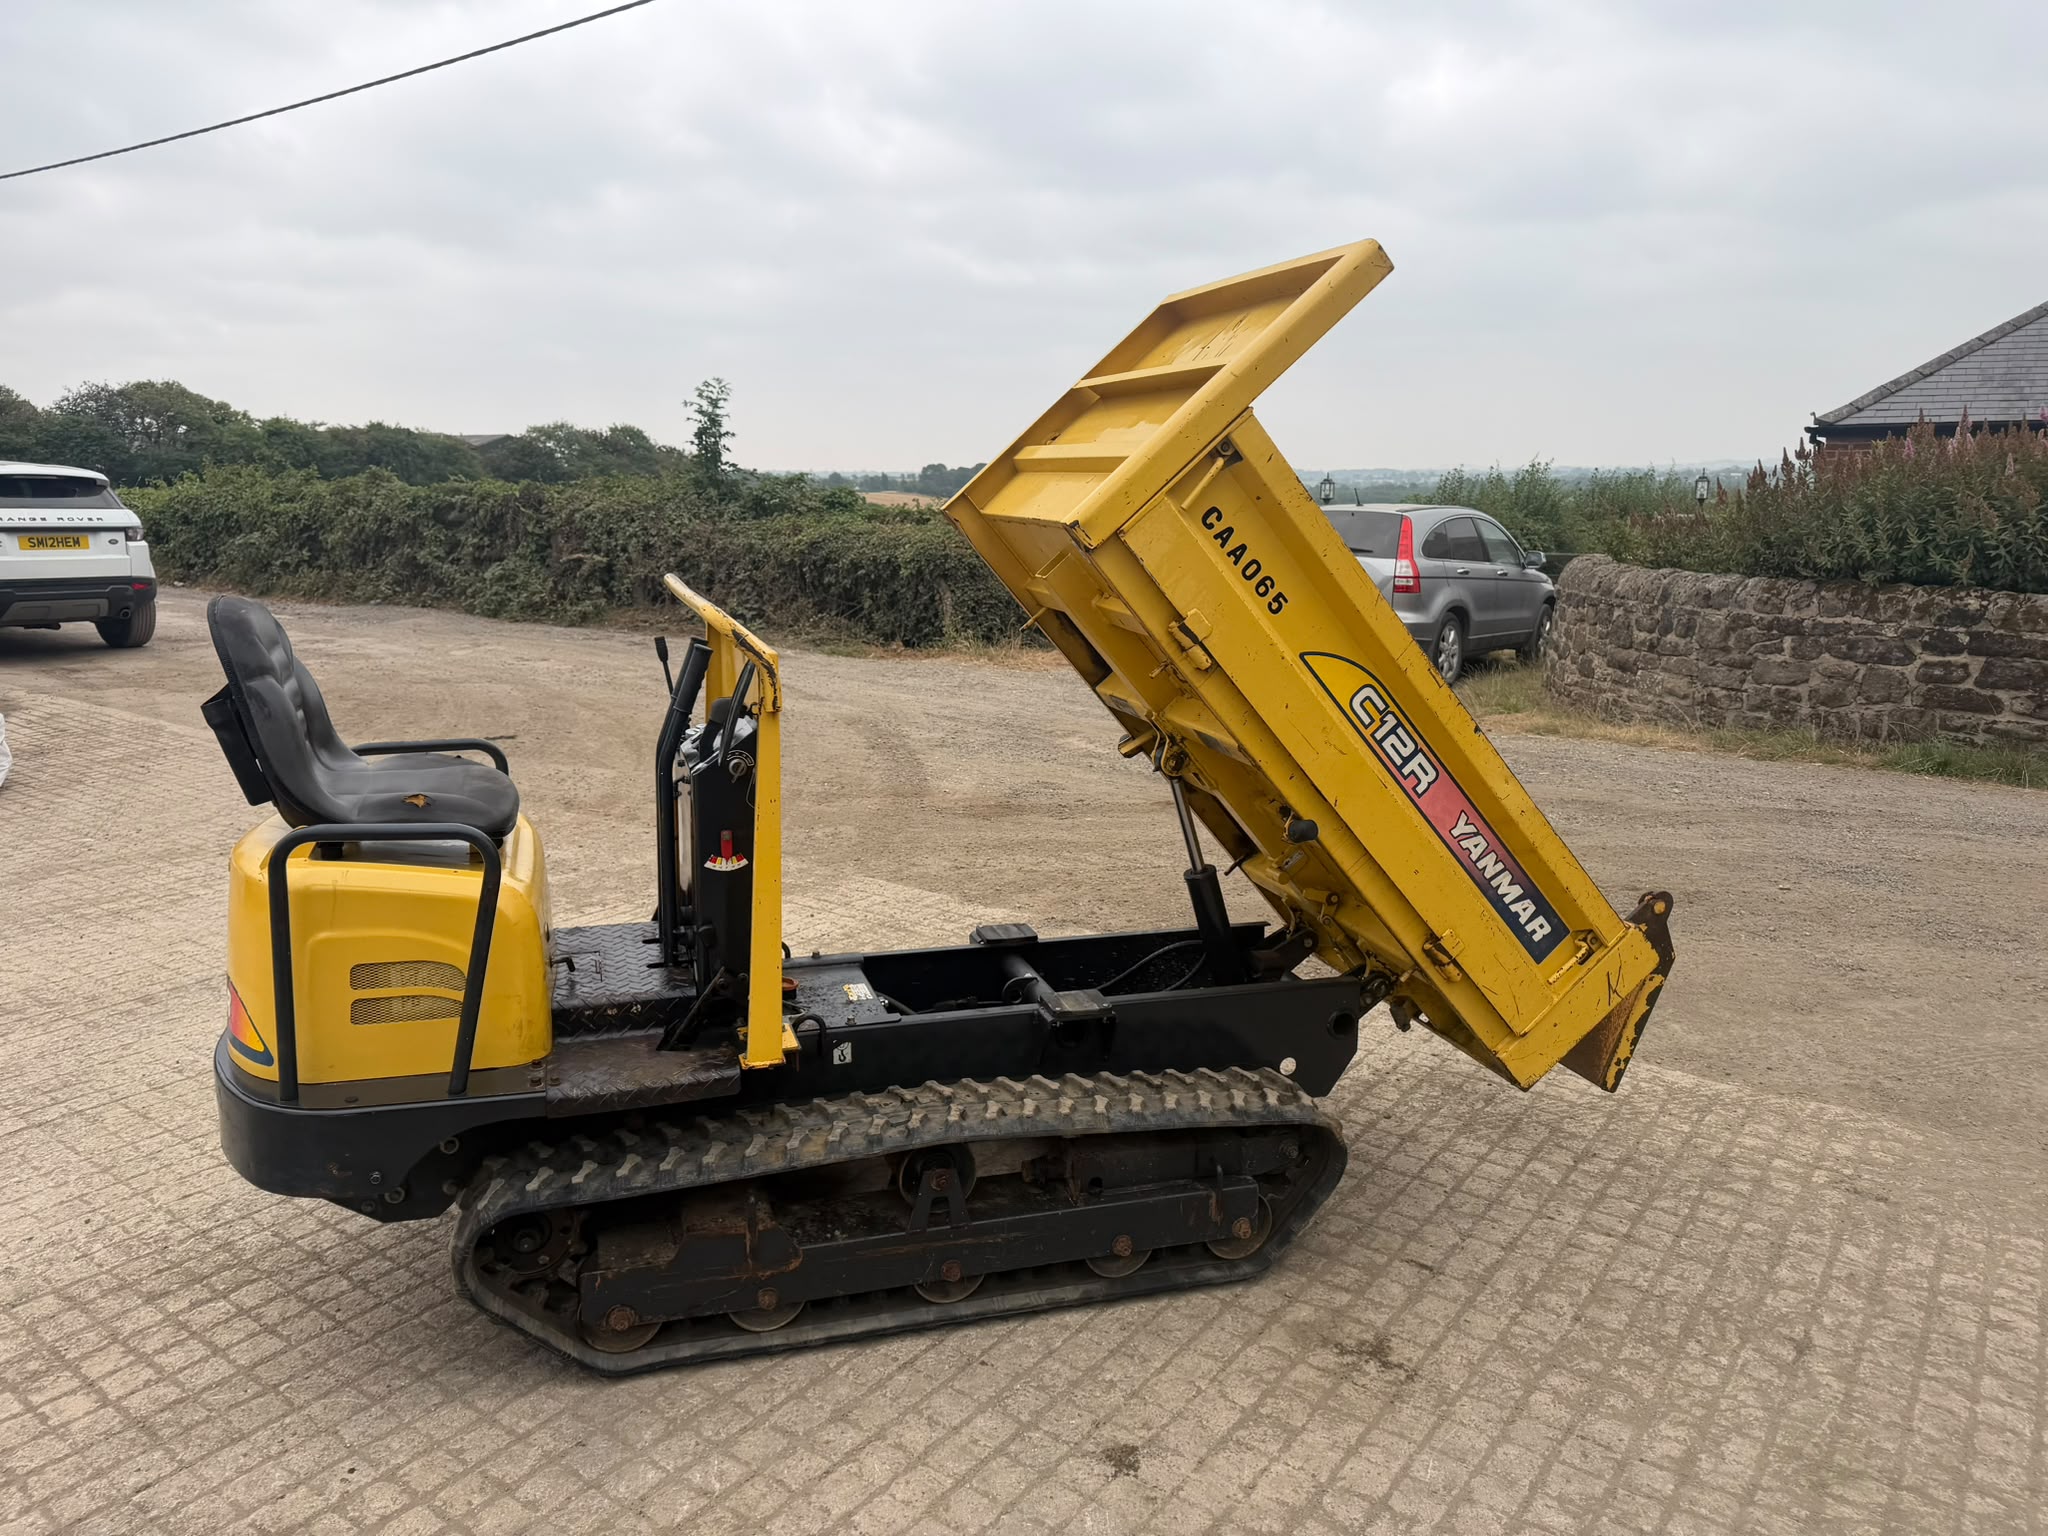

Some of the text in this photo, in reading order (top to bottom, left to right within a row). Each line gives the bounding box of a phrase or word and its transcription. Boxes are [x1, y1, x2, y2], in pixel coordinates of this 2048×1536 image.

[1201, 506, 1289, 615] CAA065
[1350, 684, 1552, 942] C12R YANMAR
